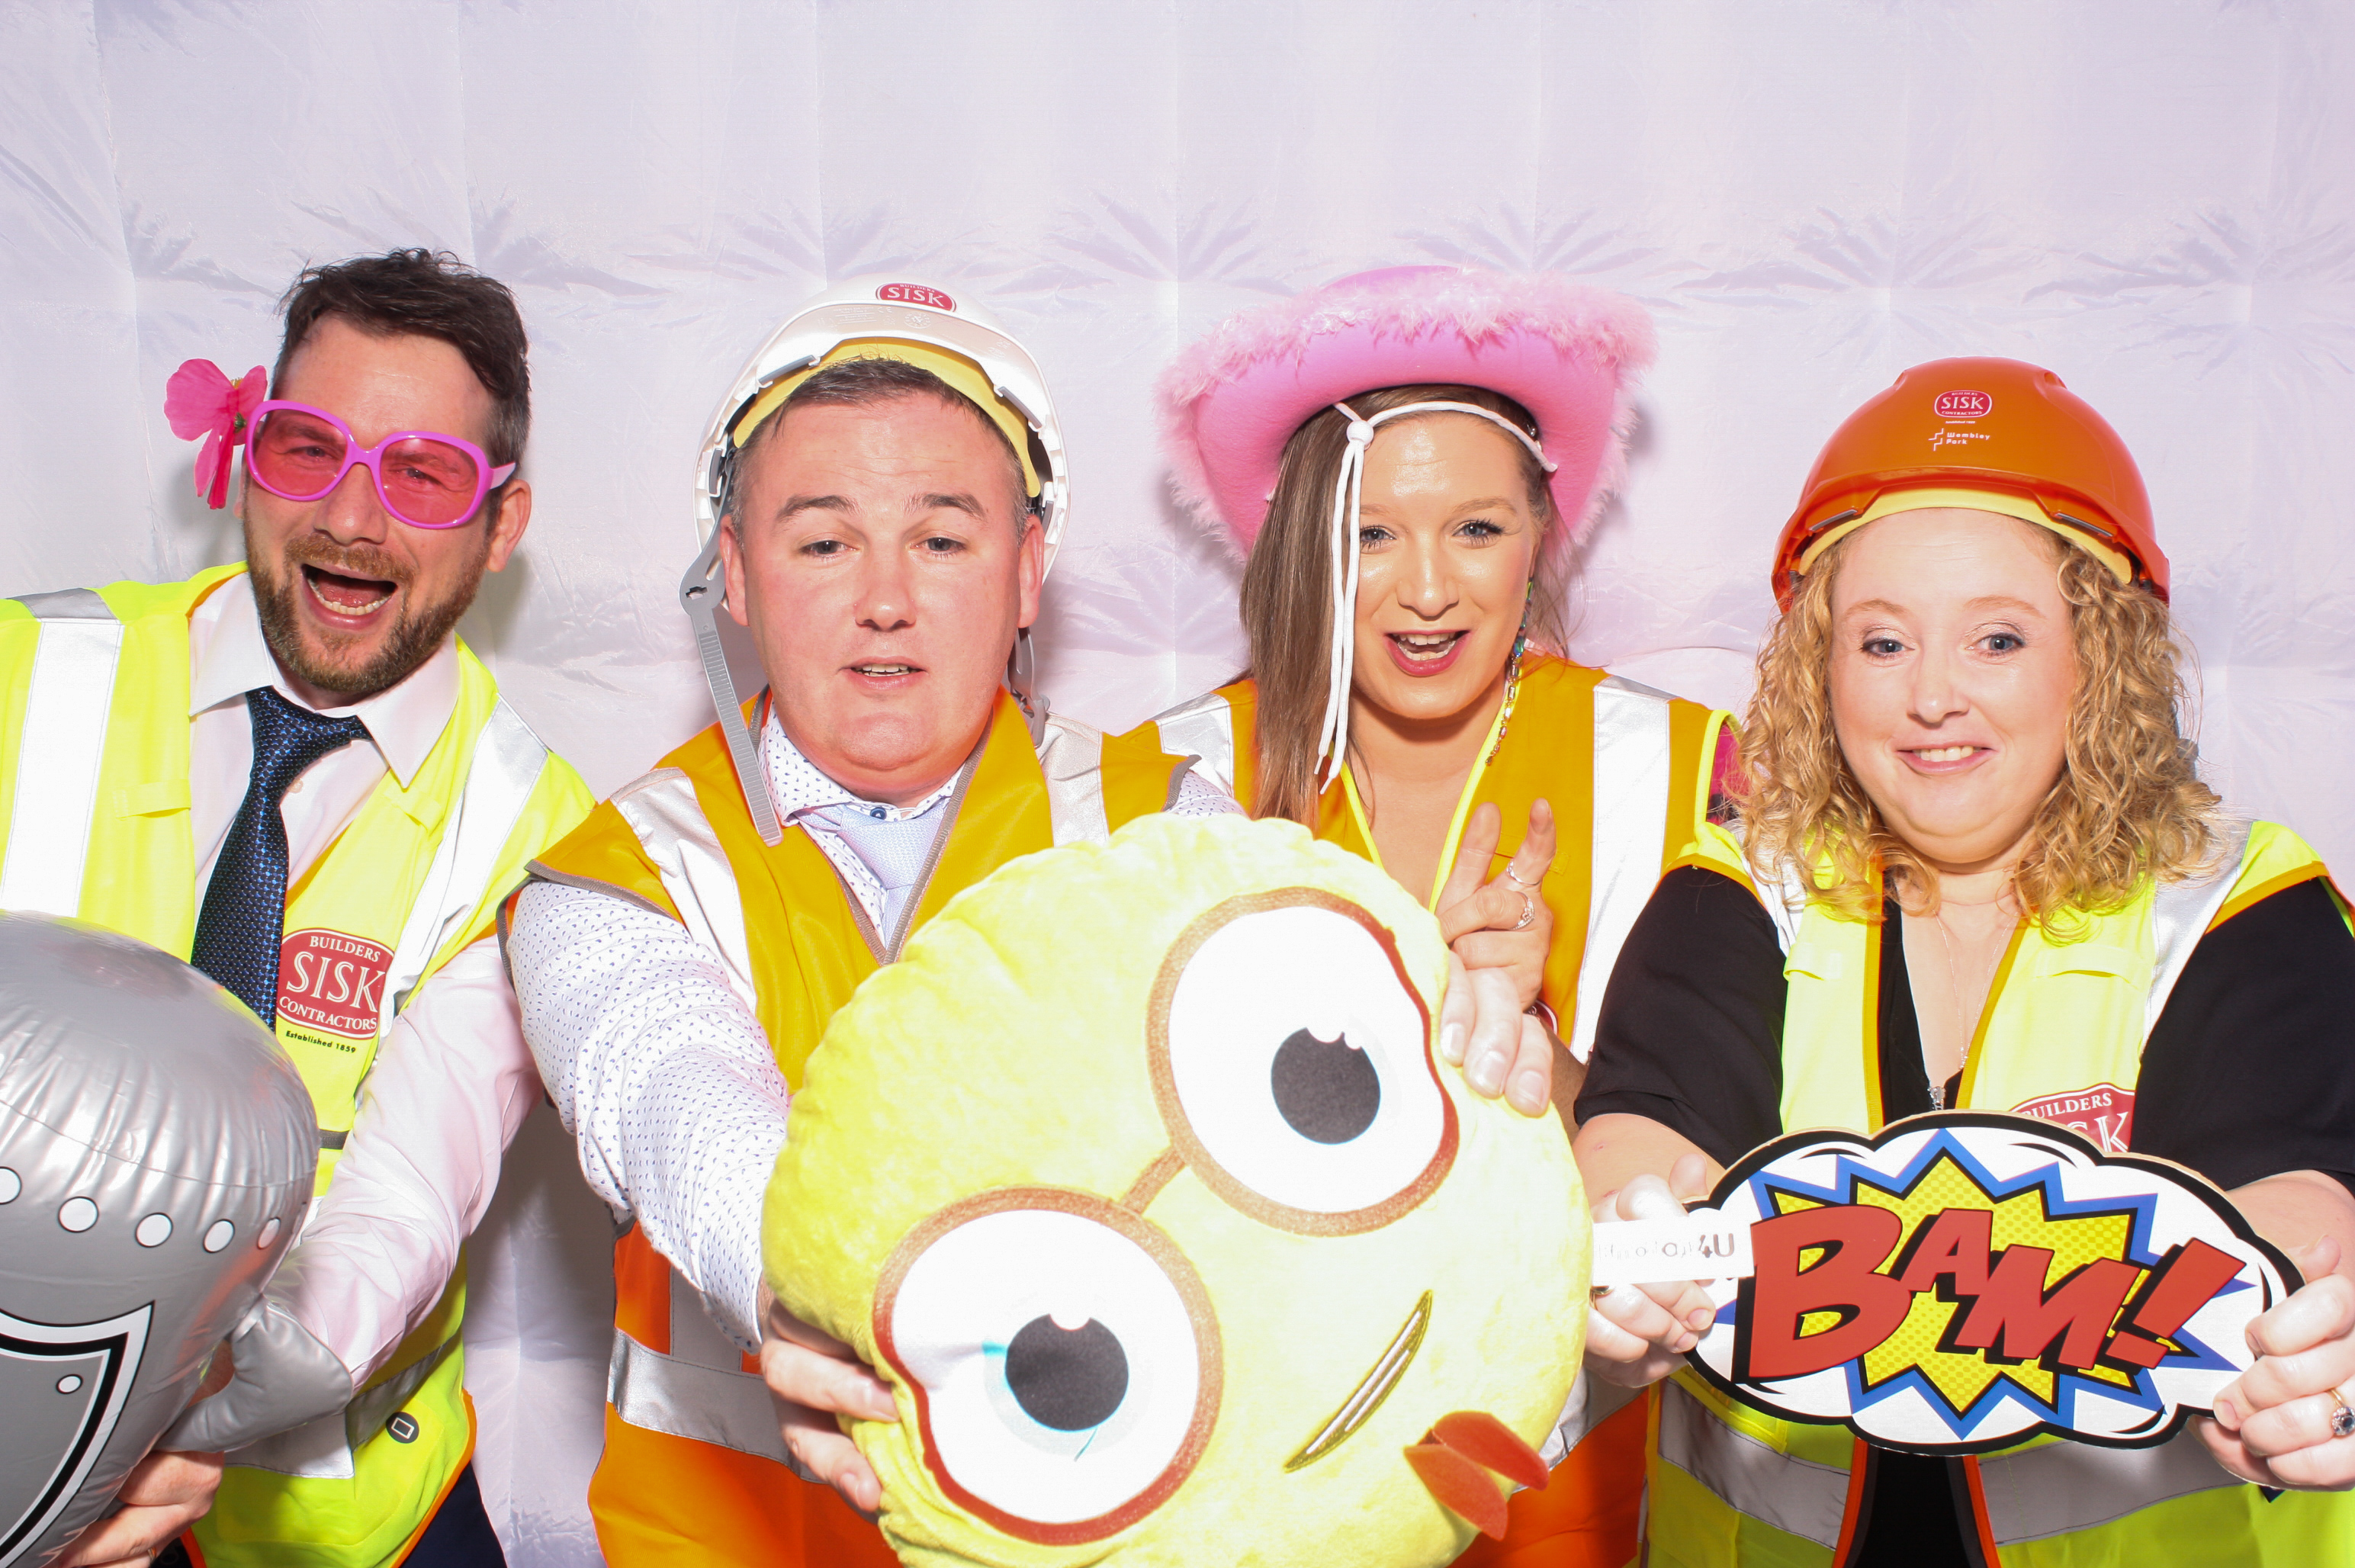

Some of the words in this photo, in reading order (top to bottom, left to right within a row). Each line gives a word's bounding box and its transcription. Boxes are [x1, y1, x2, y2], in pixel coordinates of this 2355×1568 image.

[887, 287, 945, 307] SISK
[1941, 396, 1984, 410] SISK
[1946, 432, 1990, 440] Wembley
[310, 936, 381, 962] BUILDERS
[286, 951, 386, 1013] SISK
[279, 996, 378, 1030] CONTRACTORS
[285, 1030, 333, 1048] Established
[336, 1043, 357, 1053] 1859
[1743, 1203, 2247, 1379] BAM!
